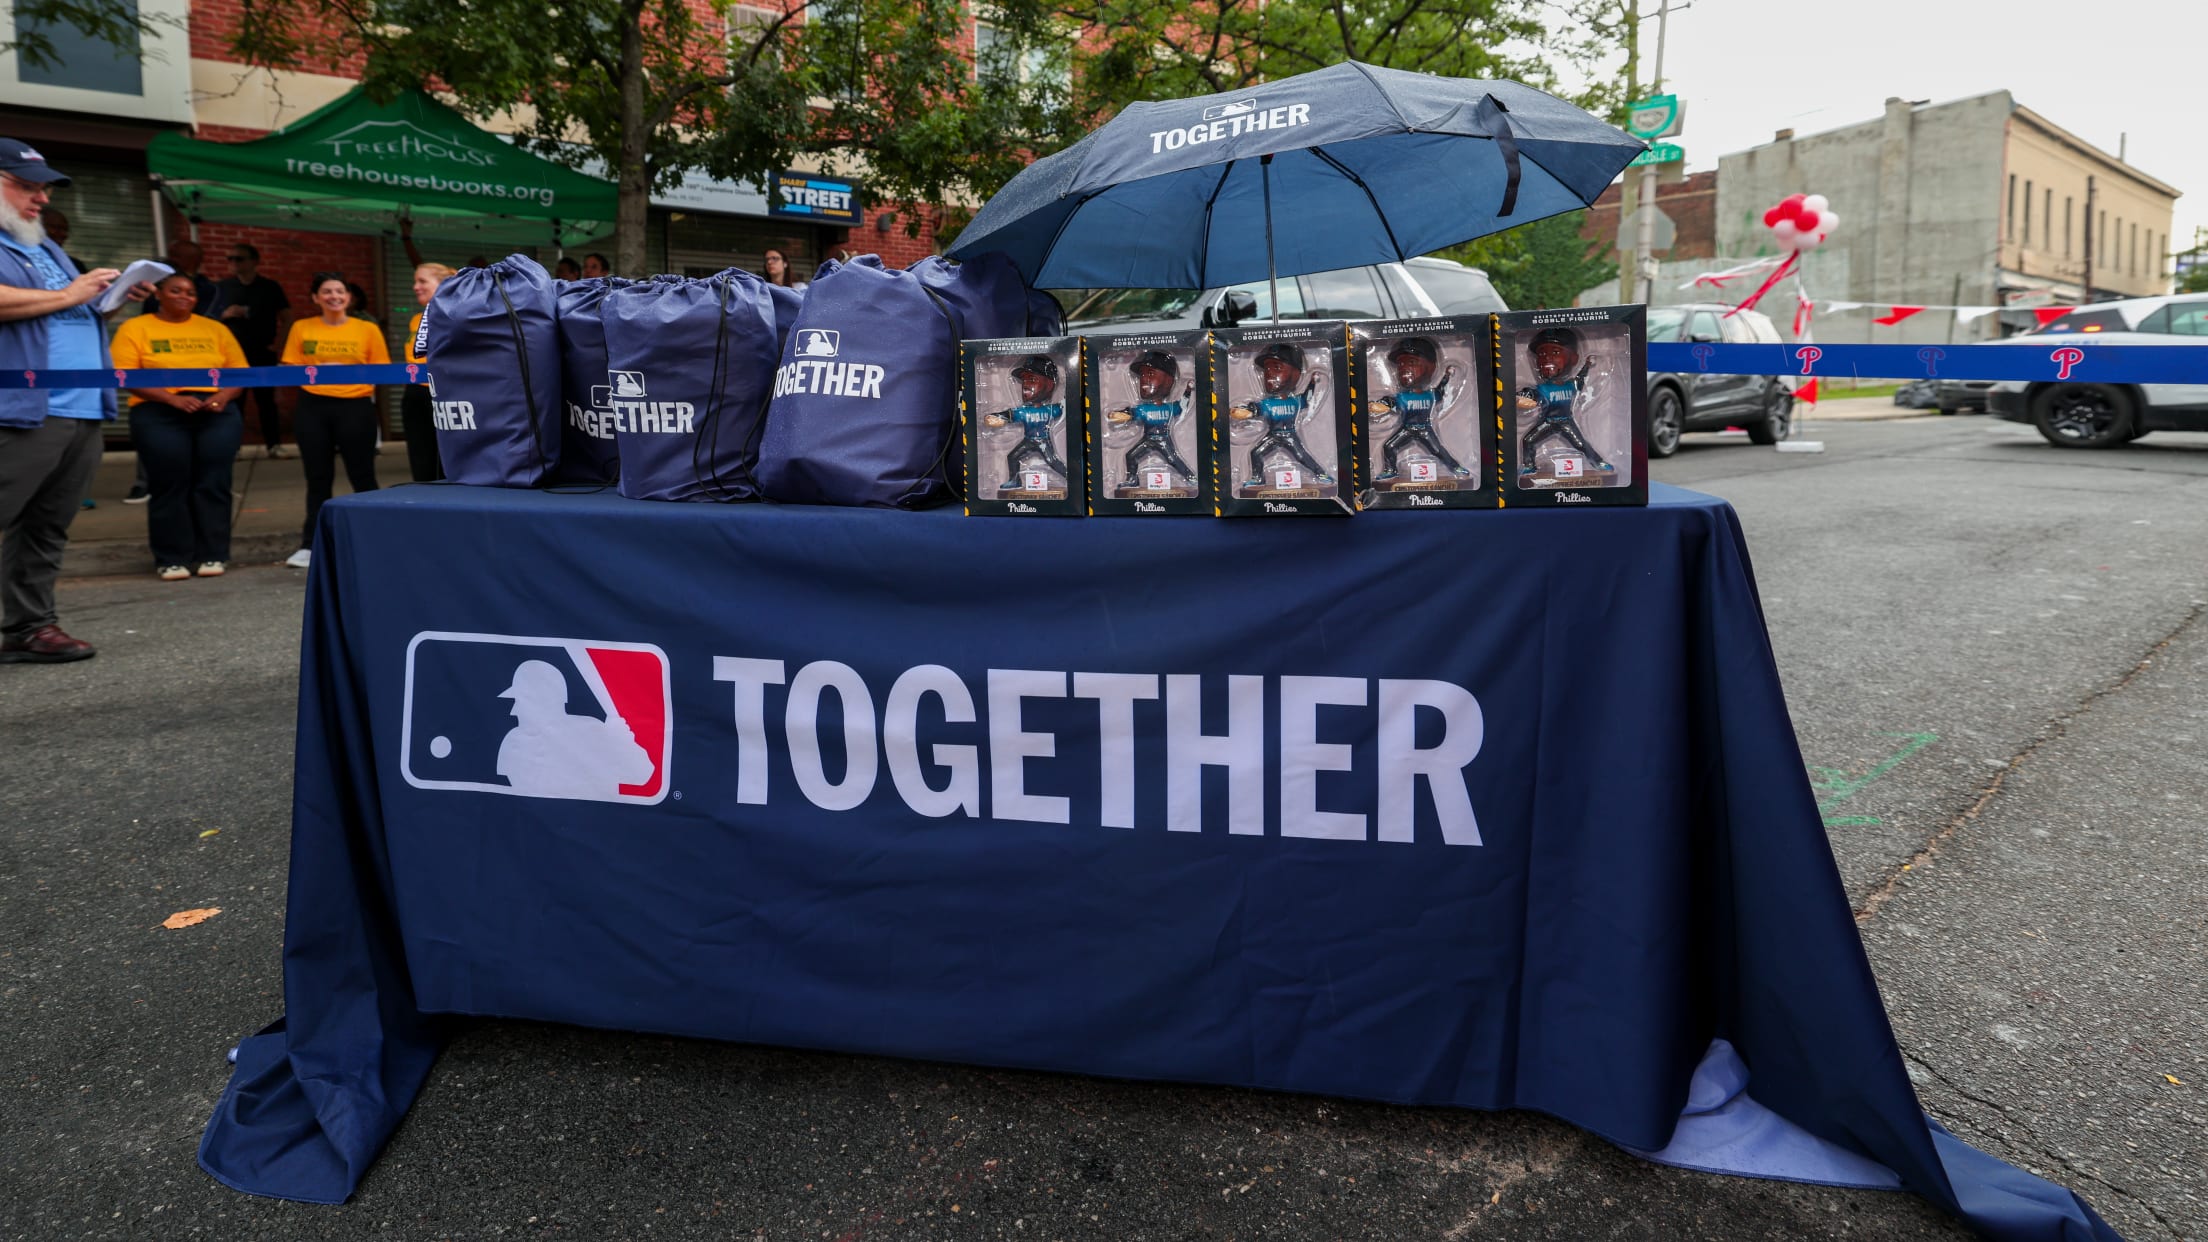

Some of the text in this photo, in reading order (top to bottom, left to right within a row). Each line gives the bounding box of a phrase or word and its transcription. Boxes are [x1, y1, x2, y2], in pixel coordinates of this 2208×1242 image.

[1150, 103, 1311, 154] TOGETHER
[779, 177, 807, 187] SHARIF
[779, 185, 852, 210] STREET
[1569, 314, 1610, 322] FIGURINE
[1796, 346, 1823, 375] P
[2050, 347, 2085, 380] P
[772, 361, 885, 400] TOGETHER
[1408, 494, 1444, 506] Phillies
[1554, 491, 1591, 503] Phillies
[1007, 502, 1037, 513] Phillies
[1134, 501, 1166, 512] Phillies
[1263, 501, 1298, 513] Phillies
[712, 656, 1484, 847] TOGETHER
